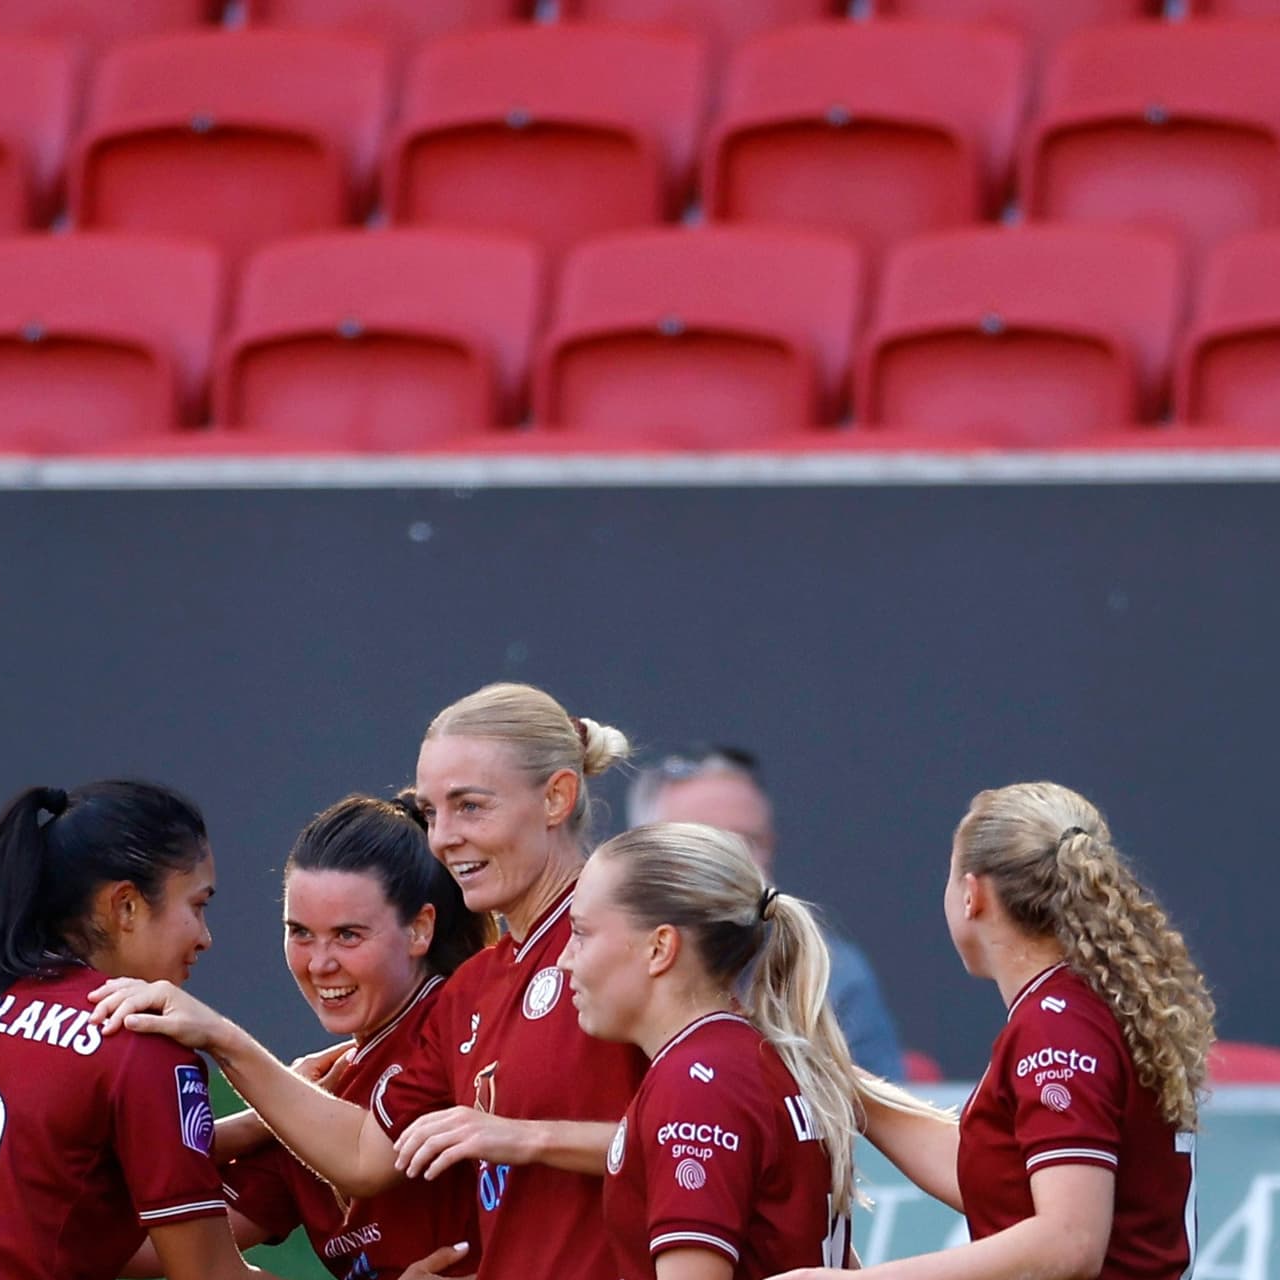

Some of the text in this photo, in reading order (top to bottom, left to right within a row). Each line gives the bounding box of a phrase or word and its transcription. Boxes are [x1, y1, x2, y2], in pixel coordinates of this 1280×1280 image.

[1016, 1047, 1098, 1078] exacta
[1034, 1067, 1075, 1087] group
[657, 1121, 739, 1152] exacta
[671, 1143, 713, 1162] group
